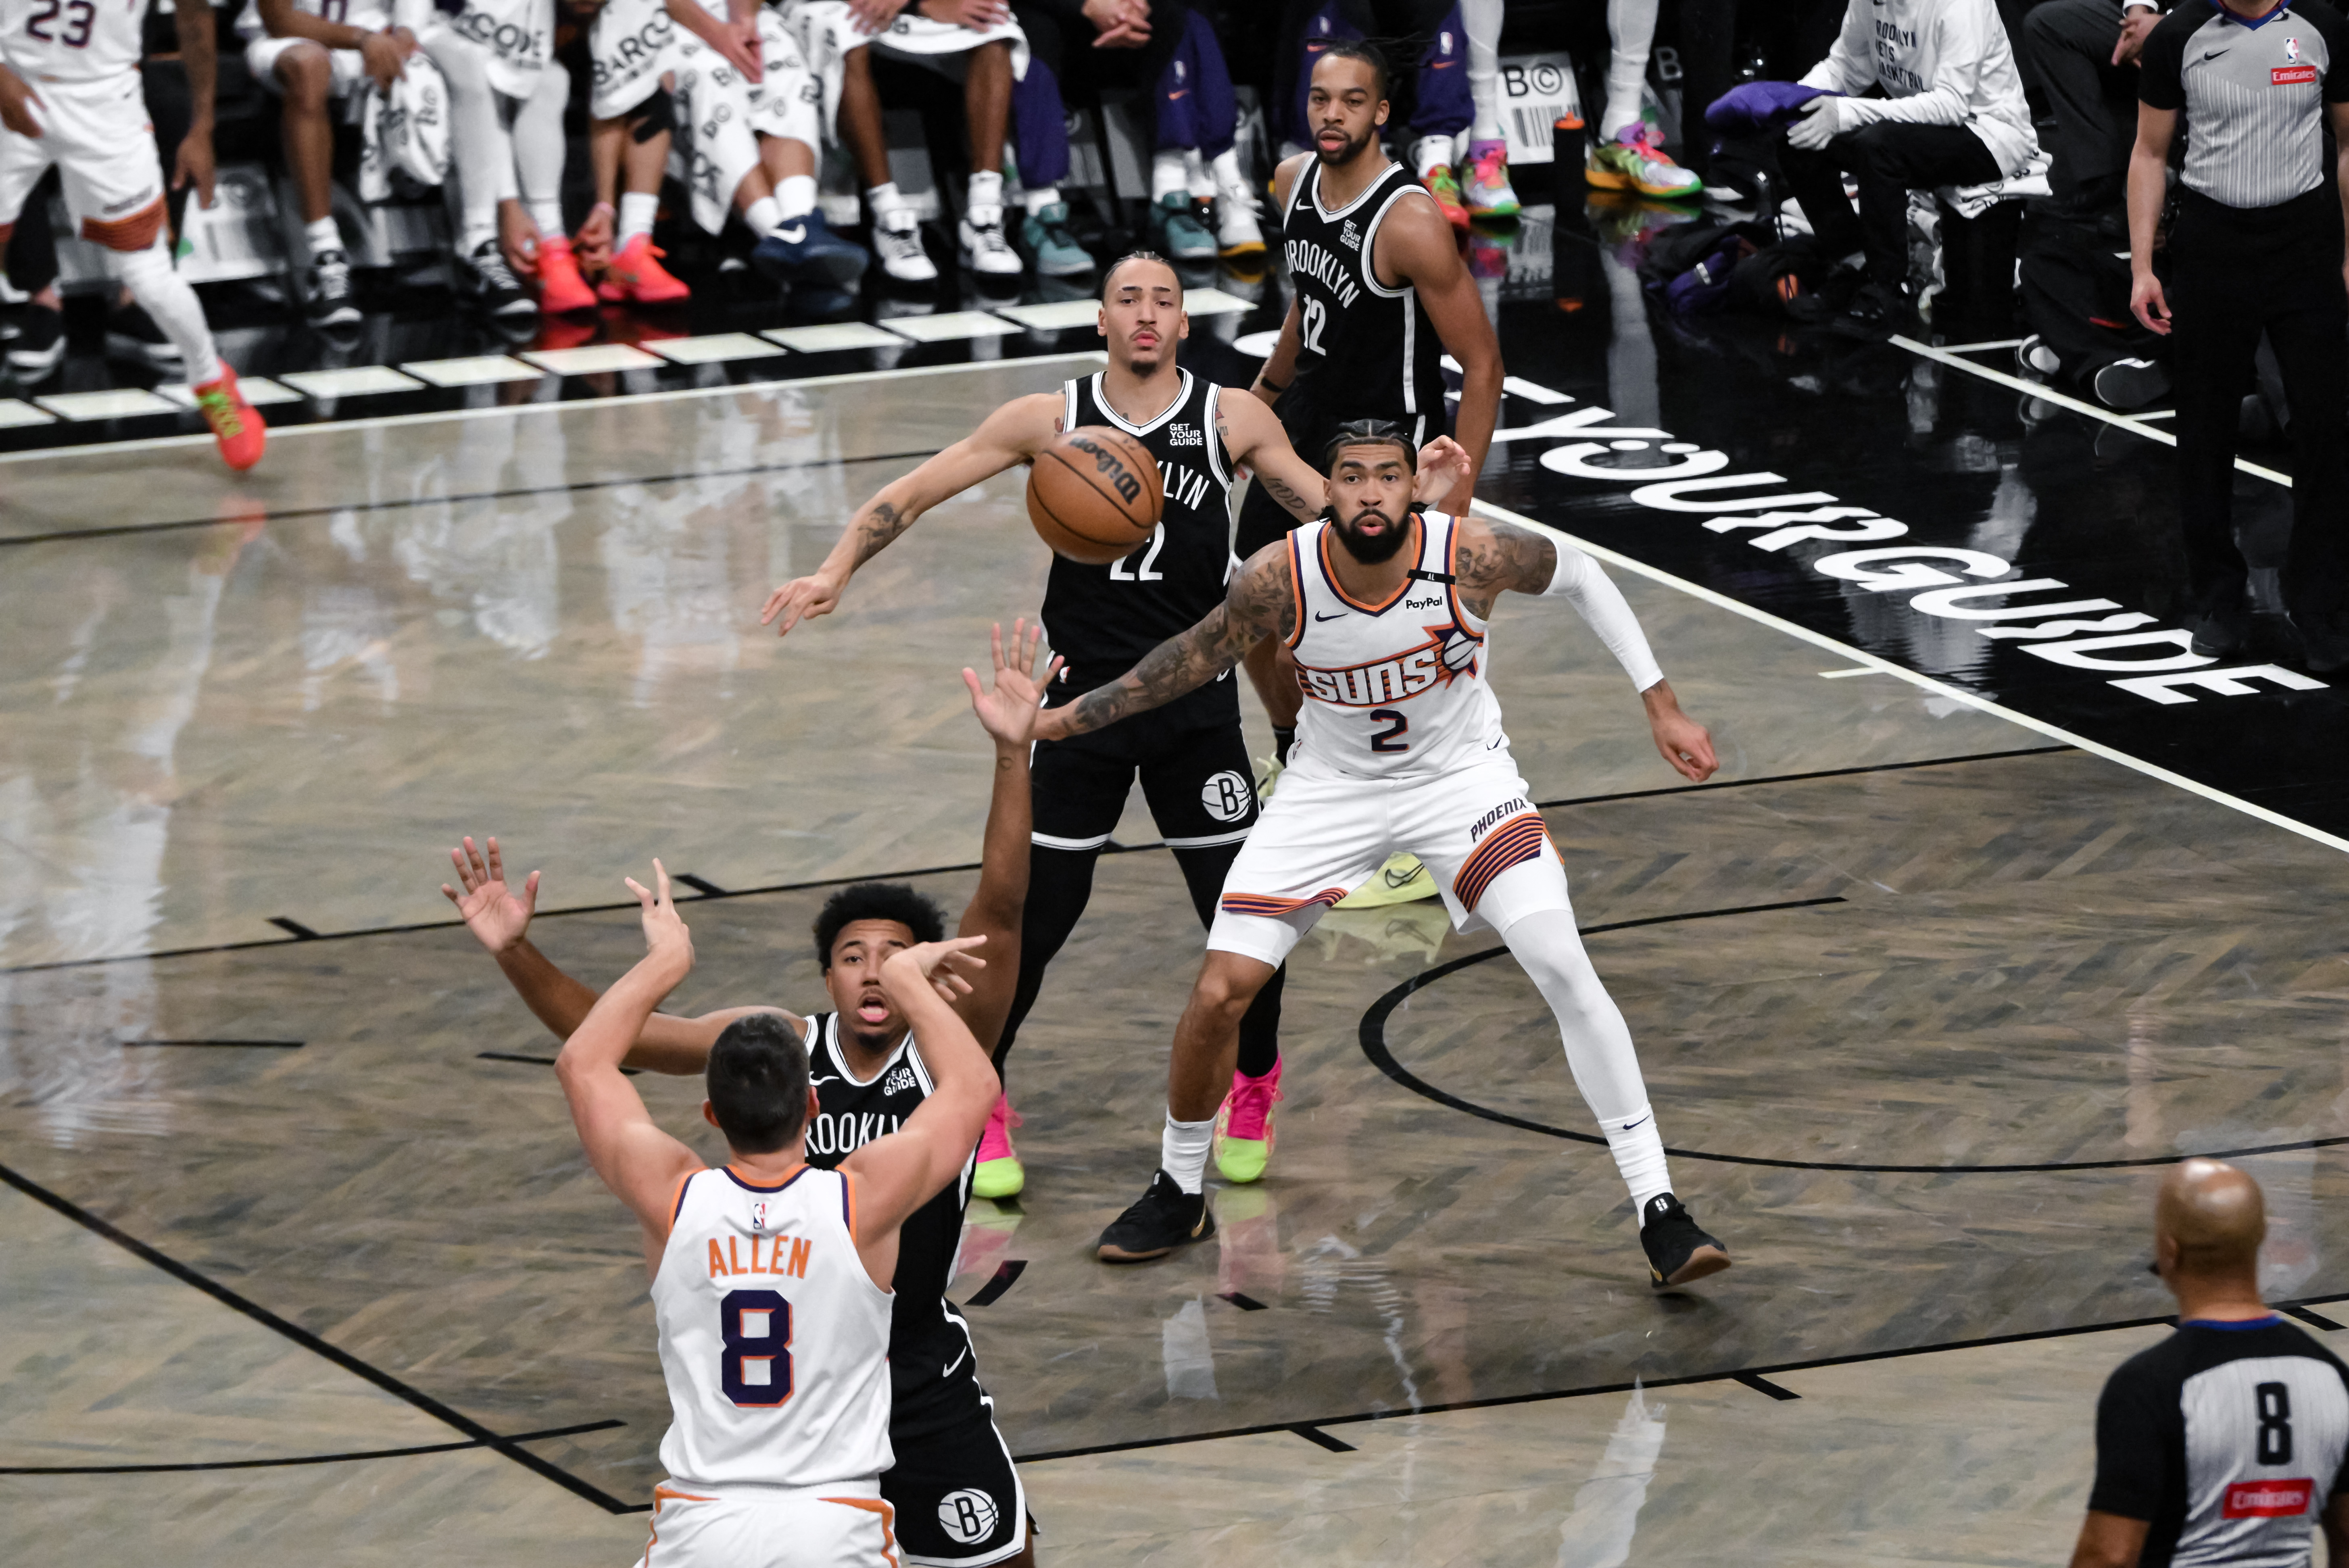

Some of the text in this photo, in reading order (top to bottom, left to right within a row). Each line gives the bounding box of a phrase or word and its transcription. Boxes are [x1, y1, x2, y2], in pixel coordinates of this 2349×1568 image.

[26, 0, 96, 48] 23
[1340, 235, 1360, 251] GUIDE
[1343, 227, 1360, 243] YOUR
[1345, 219, 1357, 231] GET
[1285, 240, 1360, 309] ROOKLYN
[1304, 294, 1326, 356] 12
[1170, 430, 1201, 438] YOUR
[1170, 437, 1203, 446] GUIDE
[1427, 573, 1435, 581] AL
[1491, 407, 2330, 705] YOUR GUIDE
[1406, 596, 1443, 610] PayPal
[1370, 709, 1410, 753] 2
[1218, 778, 1239, 815] B
[1470, 797, 1528, 844] PHOENIX
[707, 1235, 812, 1279] ALLEN
[721, 1289, 794, 1408] 8
[2255, 1381, 2293, 1466] 8
[954, 1496, 981, 1537] B
